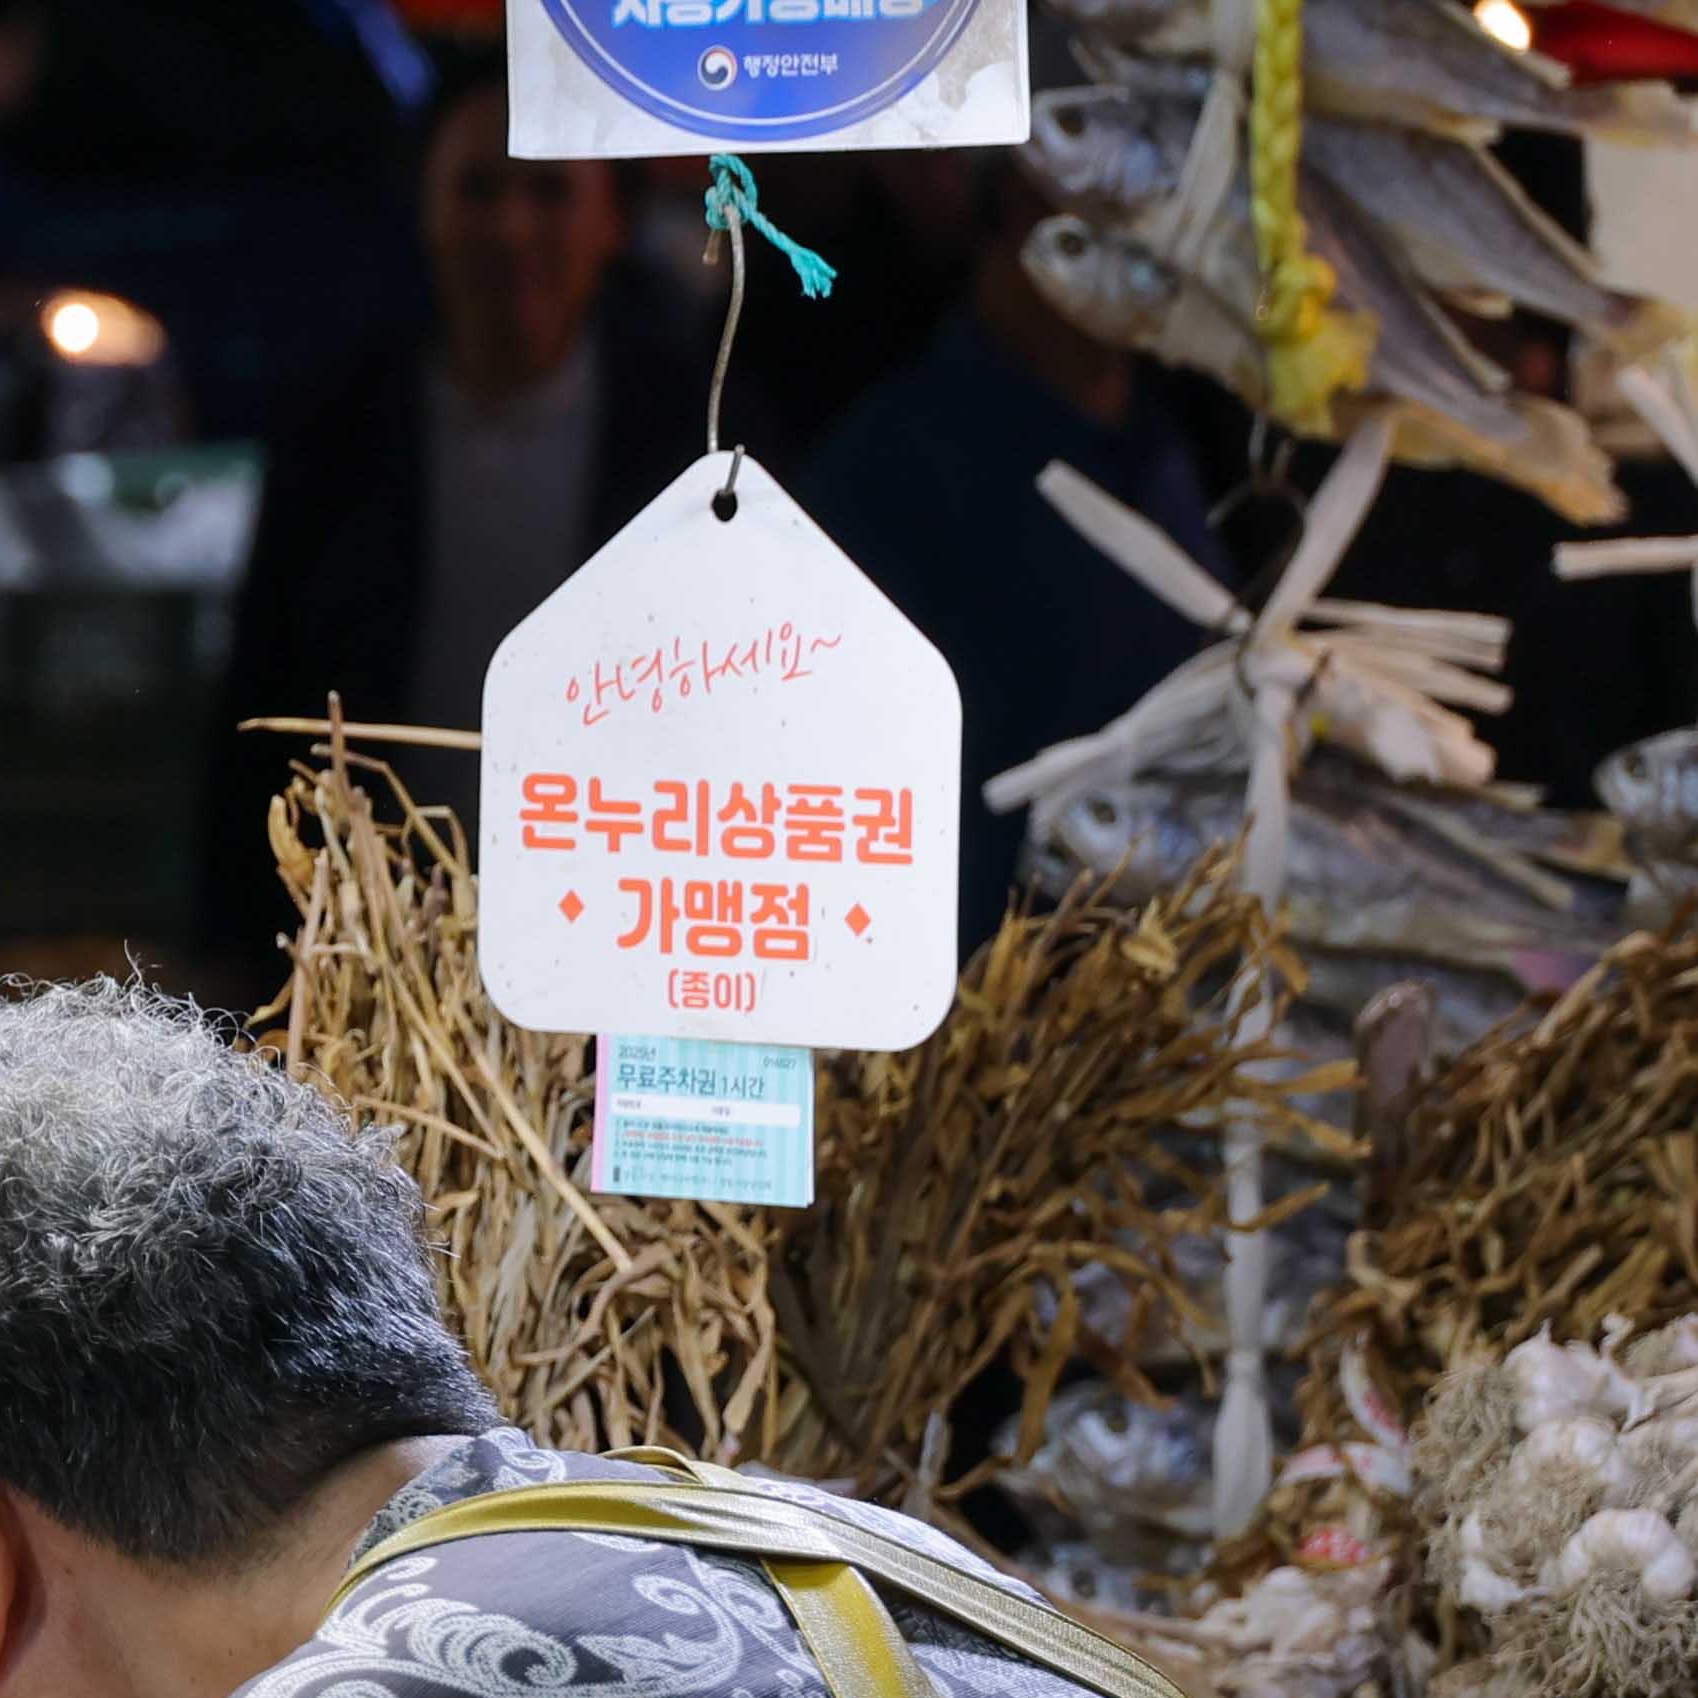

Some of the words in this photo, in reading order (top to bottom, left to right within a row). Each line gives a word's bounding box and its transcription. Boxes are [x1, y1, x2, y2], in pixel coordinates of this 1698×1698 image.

[744, 53, 839, 78] 행정안전부
[565, 621, 842, 726] 안녕하세요~
[519, 772, 913, 866] 온누리상품권
[616, 876, 810, 961] 가맹점
[668, 968, 757, 1014] (종이)
[617, 1063, 717, 1096] 무료주차권
[722, 1075, 765, 1099] 1시간
